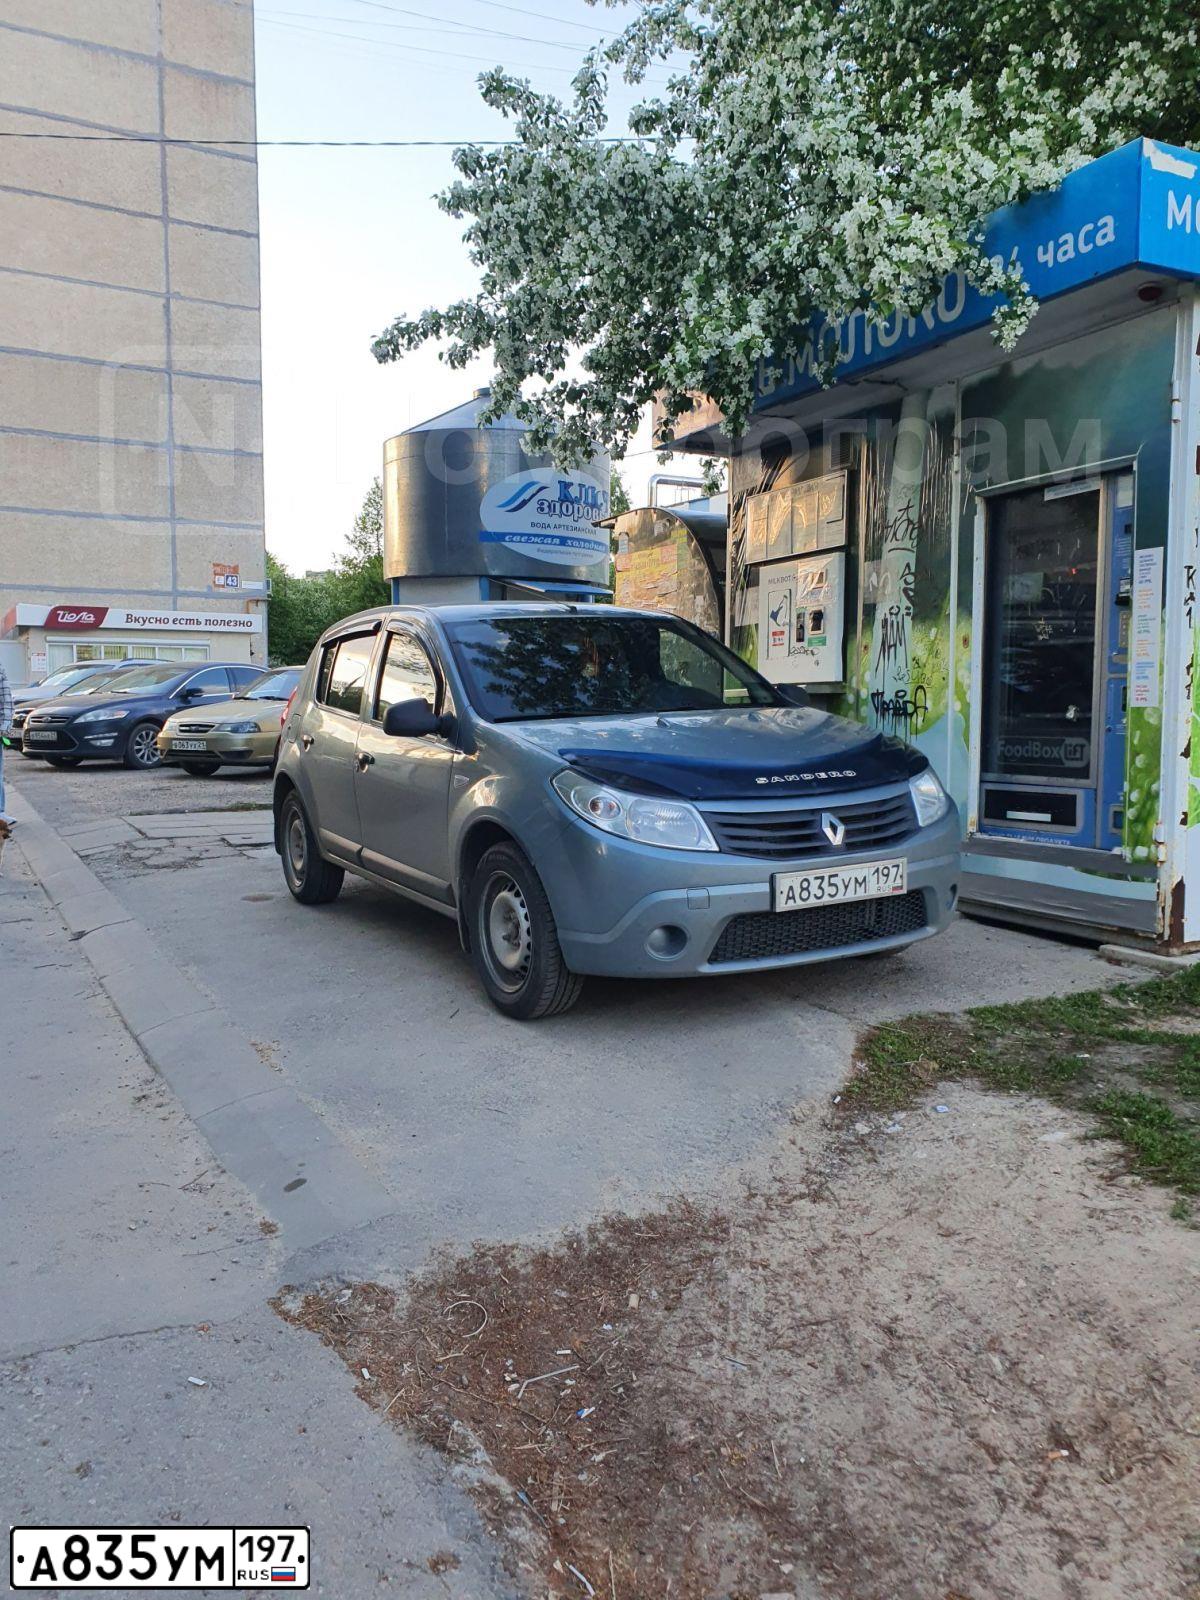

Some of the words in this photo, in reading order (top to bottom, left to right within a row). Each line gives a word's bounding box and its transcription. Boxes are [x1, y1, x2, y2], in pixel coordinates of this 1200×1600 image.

[1167, 190, 1200, 235] М
[1037, 214, 1116, 268] часа
[530, 521, 552, 531] ВОДА
[505, 534, 560, 546] свежая
[226, 576, 237, 586] 43
[125, 613, 170, 627] Вкусно
[172, 616, 202, 626] есть
[204, 618, 253, 628] полезно
[996, 739, 1060, 759] FoodBox
[755, 769, 857, 784] SANDERO
[784, 873, 867, 905] А835УМ
[871, 864, 900, 885] 197
